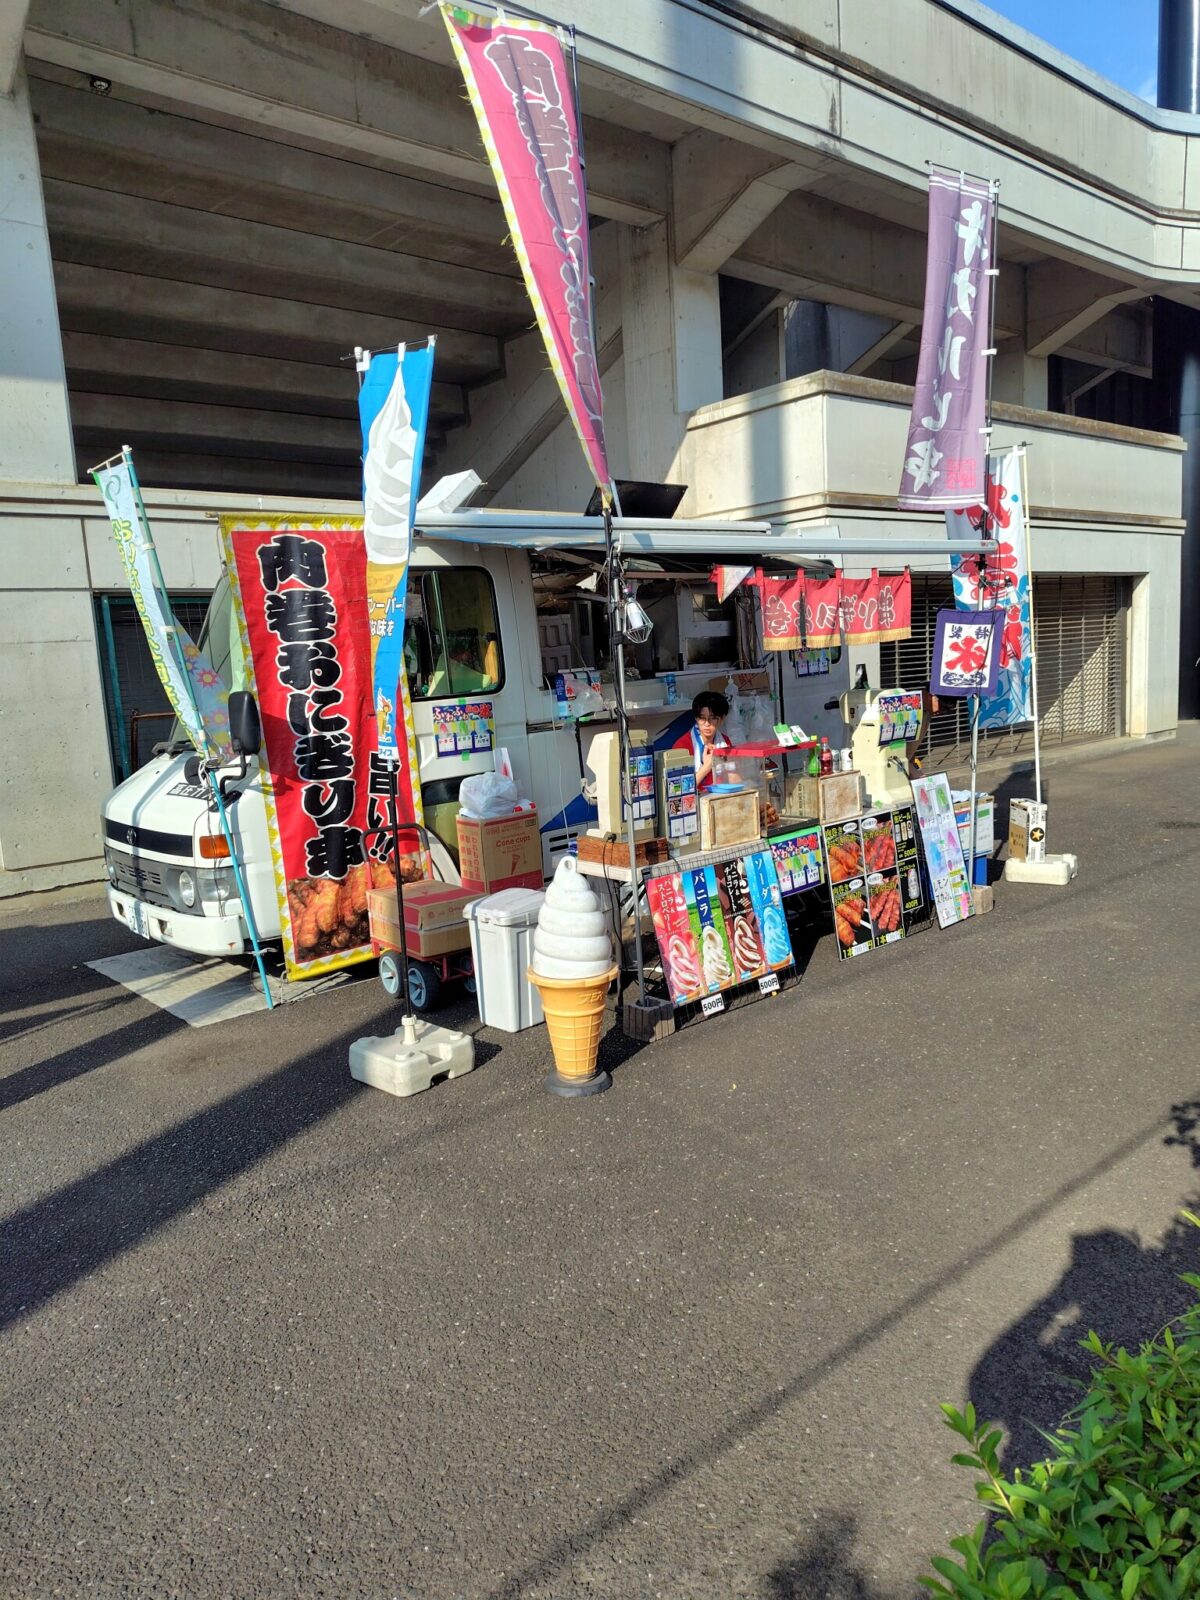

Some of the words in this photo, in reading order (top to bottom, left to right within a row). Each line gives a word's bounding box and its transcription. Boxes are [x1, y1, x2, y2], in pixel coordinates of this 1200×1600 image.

[256, 534, 365, 880] 肉巻おにぎり串
[694, 872, 709, 917] バニラ
[724, 866, 737, 912] チョコレート
[755, 859, 769, 901] ソーダ
[657, 883, 671, 931] ストロベリー
[703, 997, 724, 1012] 500円
[760, 977, 778, 990] 500円
